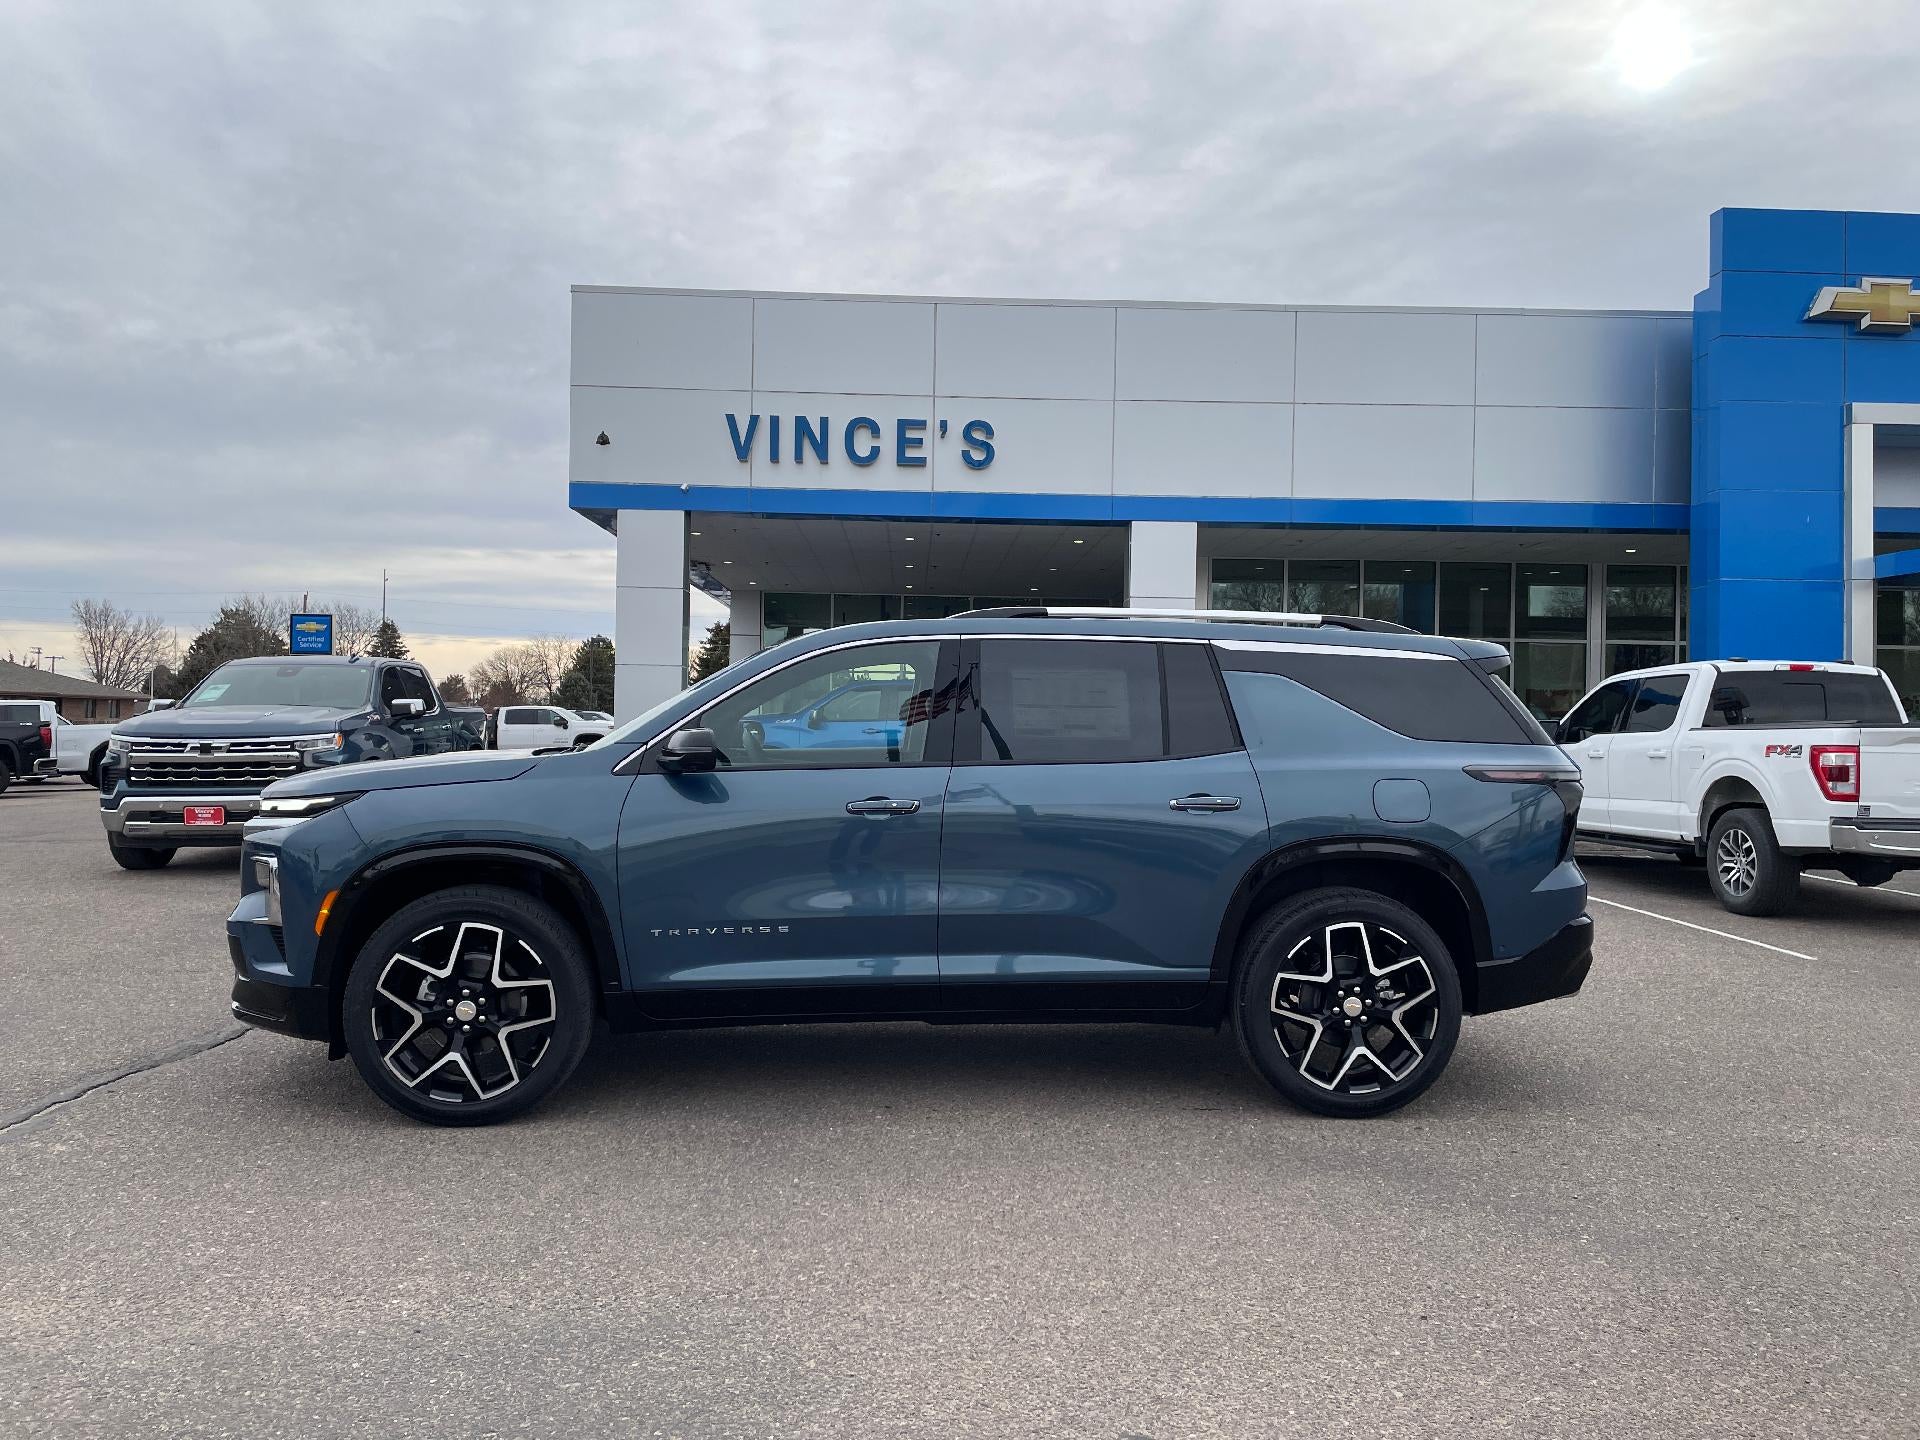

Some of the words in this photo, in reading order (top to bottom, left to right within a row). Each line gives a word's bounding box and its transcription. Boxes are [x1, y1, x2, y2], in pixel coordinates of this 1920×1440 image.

[725, 413, 995, 470] VINCE'S
[1764, 744, 1803, 757] FX4
[650, 926, 789, 937] TRAVERSE
